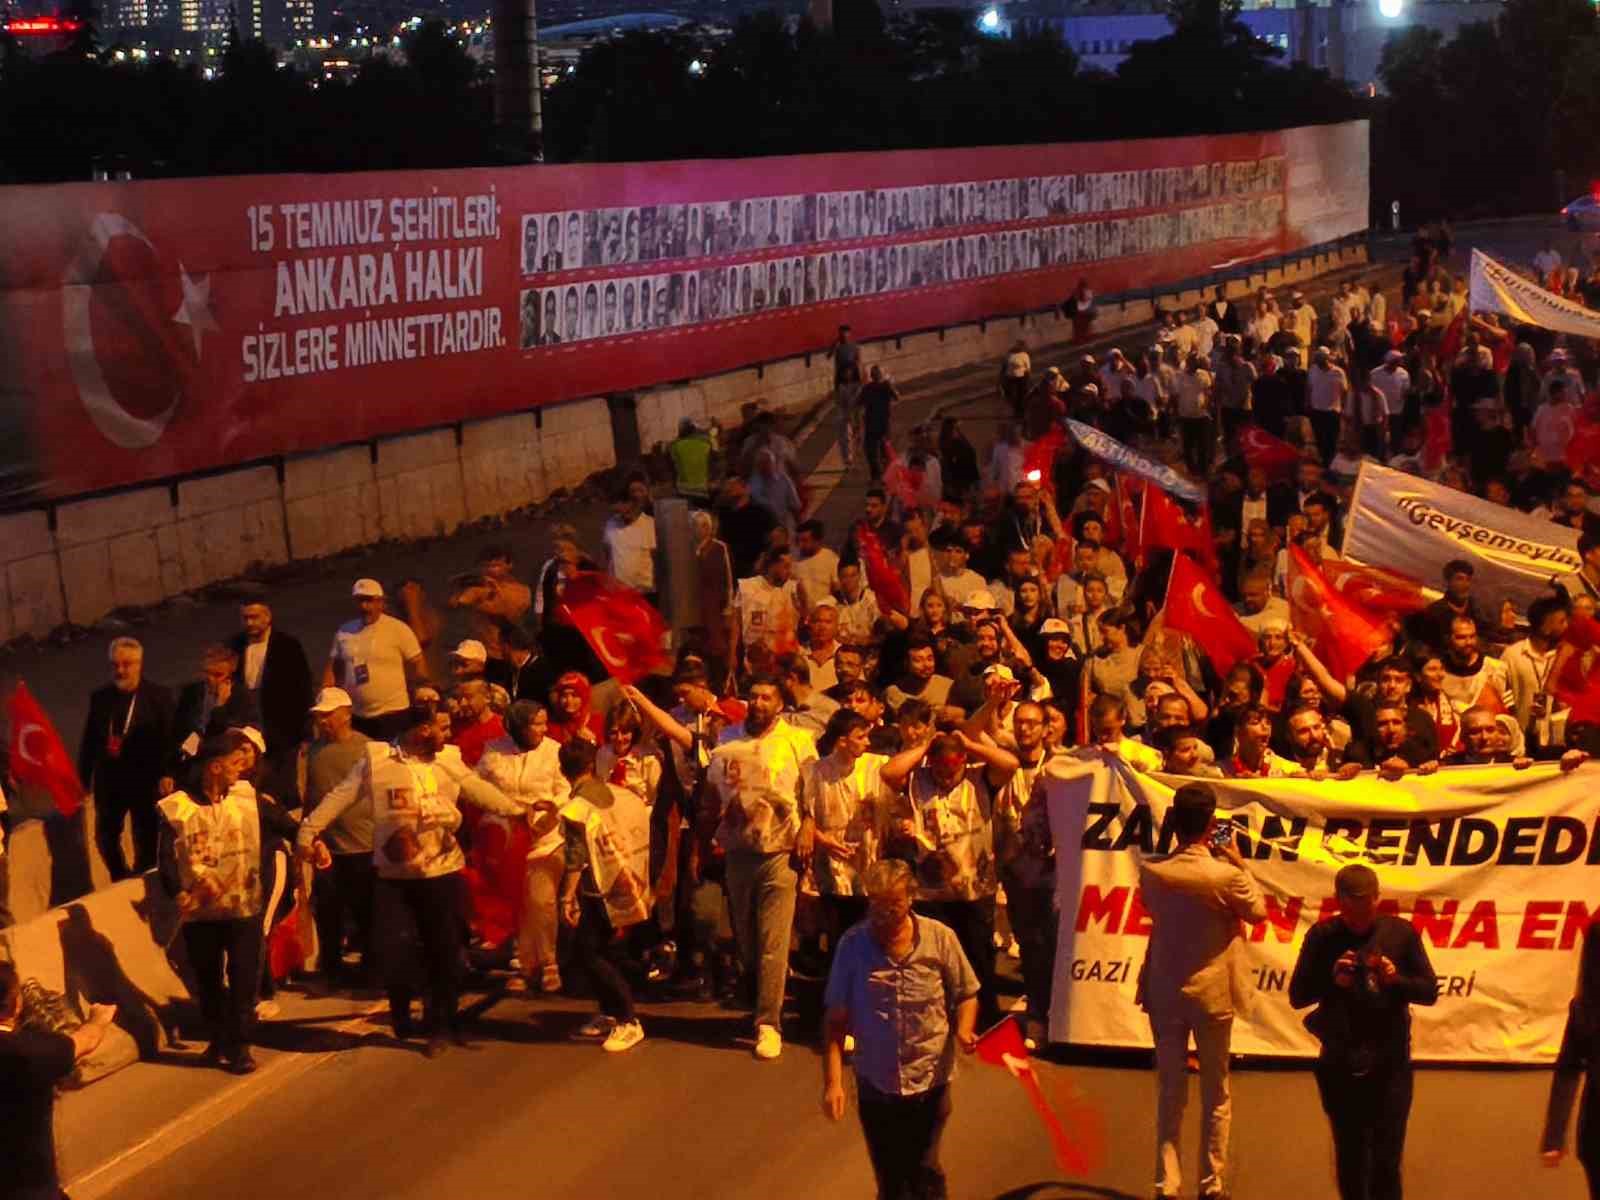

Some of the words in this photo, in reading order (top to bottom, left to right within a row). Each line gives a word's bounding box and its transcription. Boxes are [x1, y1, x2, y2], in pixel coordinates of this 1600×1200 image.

[247, 204, 275, 251] 15
[280, 199, 385, 249] TEMMUZ
[273, 252, 399, 317] ANKARA
[404, 246, 484, 302] HALKI
[241, 321, 339, 383] SİZLERE
[344, 307, 506, 368] MİNNETTARDIR.
[1081, 802, 1308, 861] ZAAN
[1071, 956, 1133, 984] GAZİ
